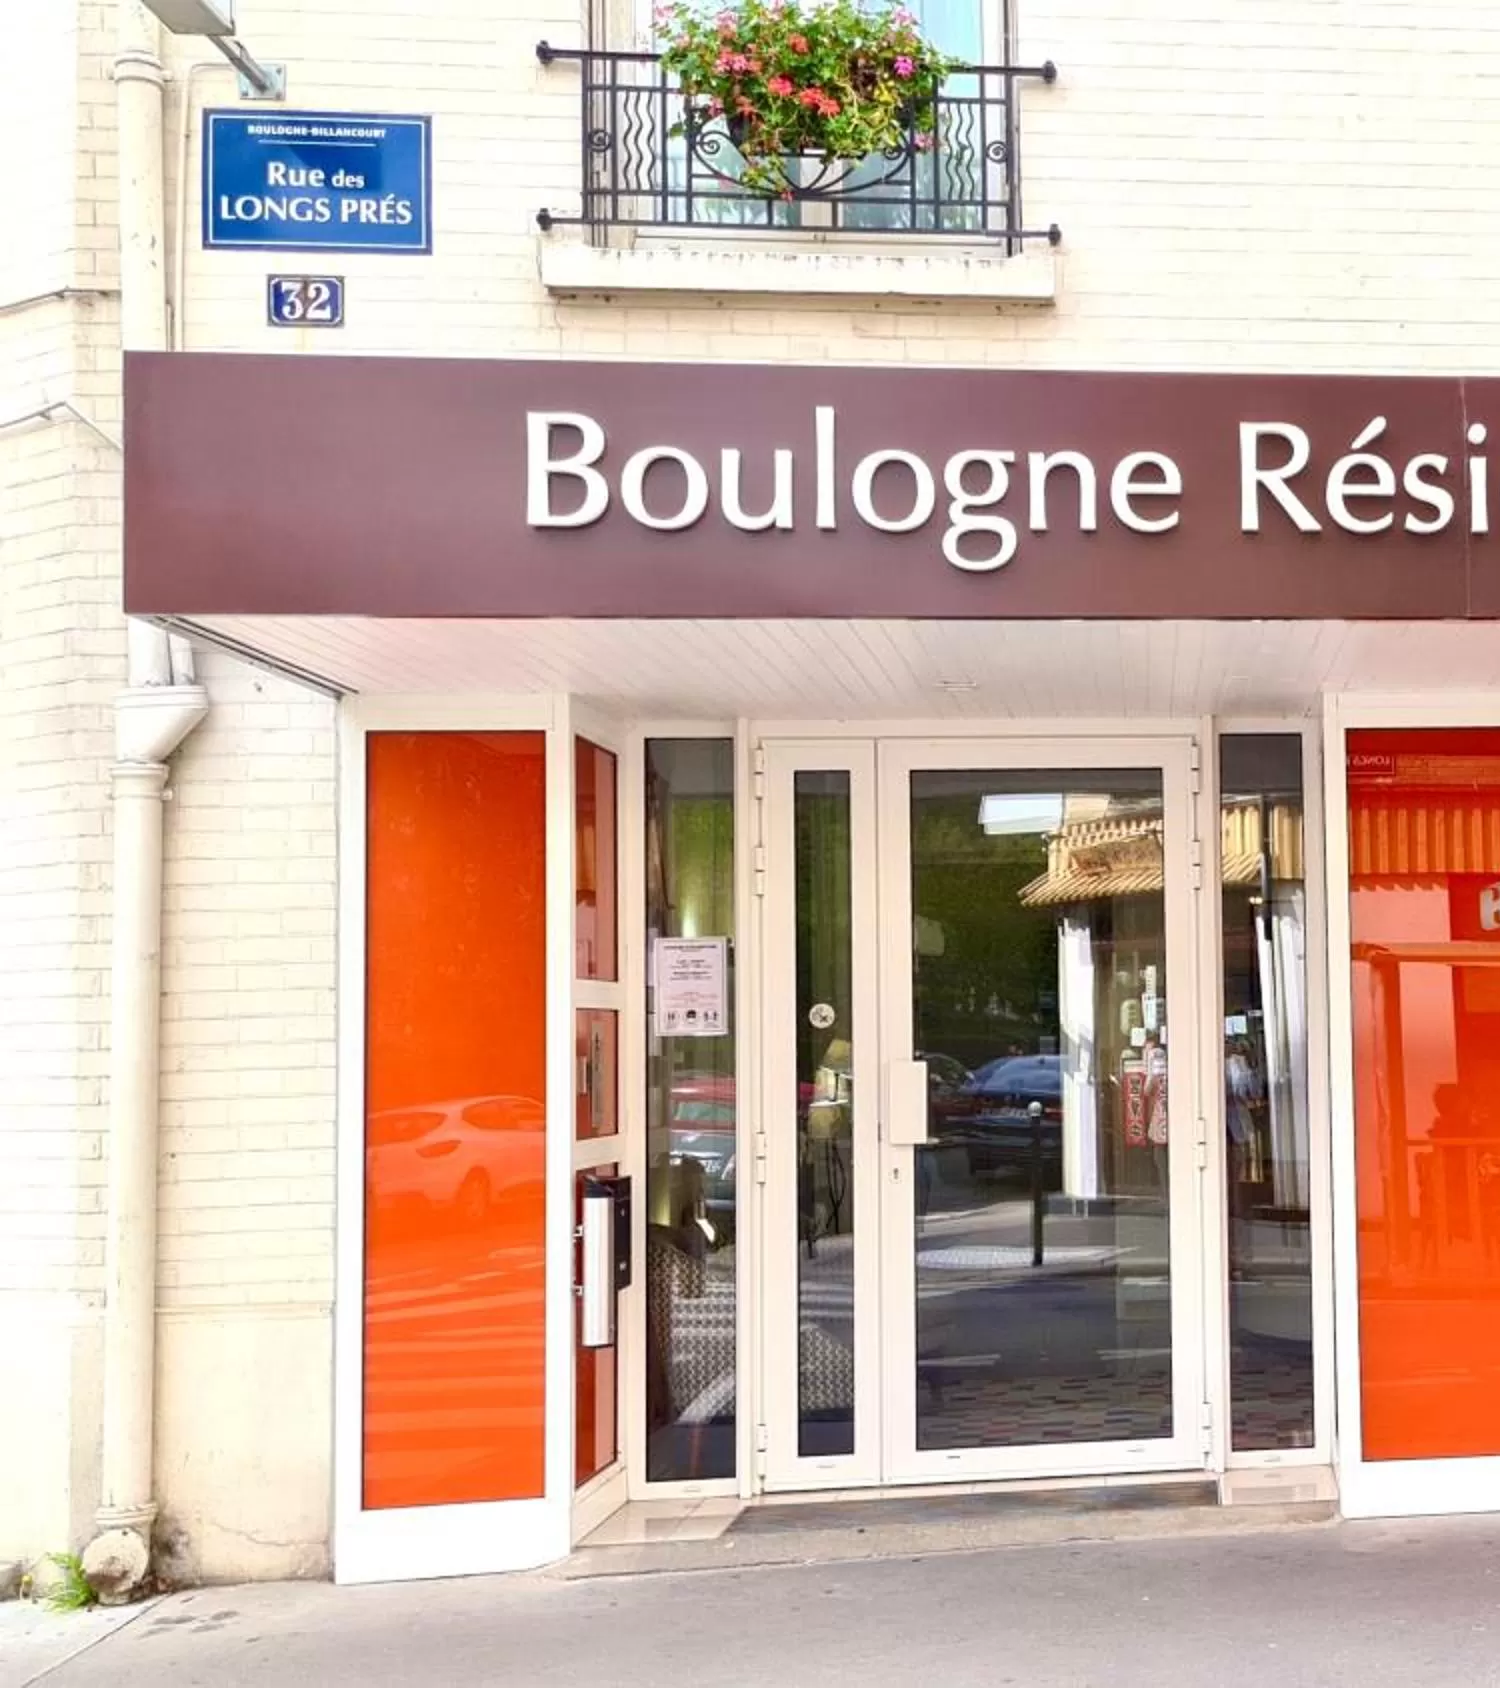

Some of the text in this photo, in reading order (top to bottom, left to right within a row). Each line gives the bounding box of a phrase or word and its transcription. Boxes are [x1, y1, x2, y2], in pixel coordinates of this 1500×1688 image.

[247, 124, 386, 138] BOULOGNE-BILLANCOURT
[267, 161, 365, 188] Rue des
[220, 193, 413, 225] LONGS PRÉS
[281, 281, 332, 320] 32
[526, 406, 1182, 571] Boulogne
